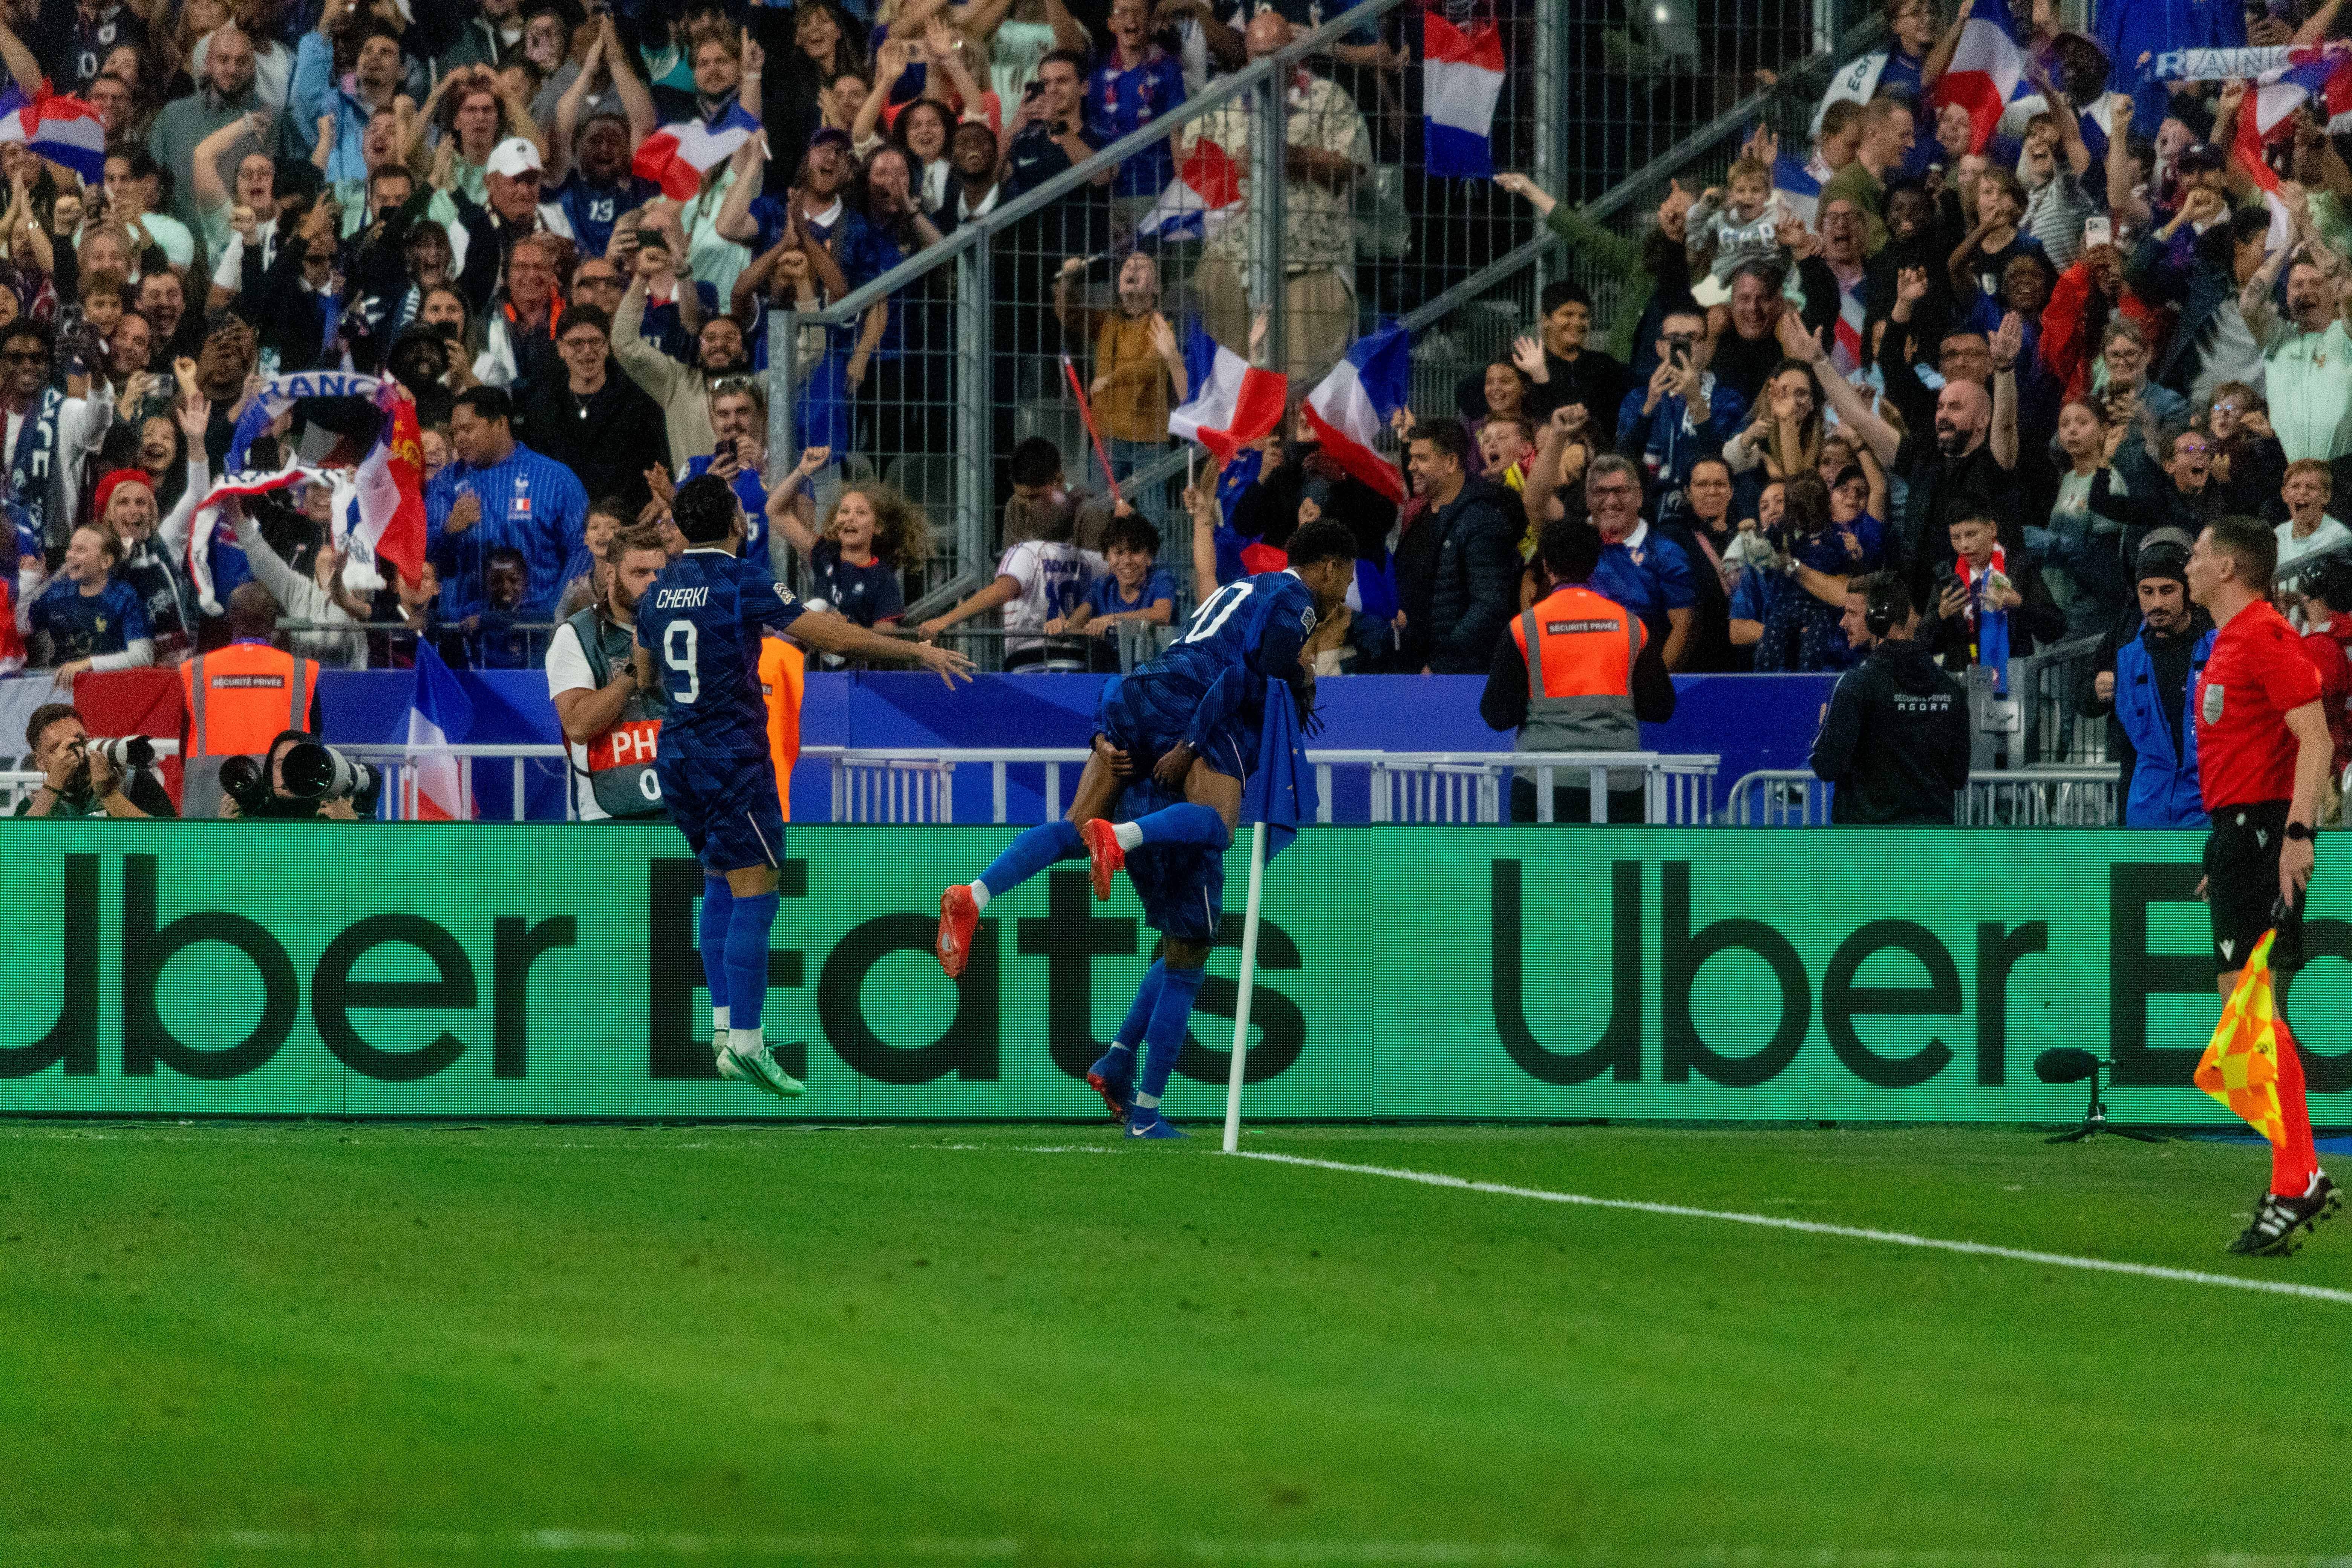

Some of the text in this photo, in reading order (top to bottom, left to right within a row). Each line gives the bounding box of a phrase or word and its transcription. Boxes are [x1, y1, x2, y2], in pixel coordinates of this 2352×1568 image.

[656, 586, 709, 608] CHERKI
[1169, 581, 1253, 646] 10
[1550, 622, 1618, 632] SÉCURITÉ PRIVÉE
[213, 677, 282, 687] SÉCURITÉ PRIVÉE
[663, 620, 699, 703] 9
[0, 853, 577, 1081] Uber
[1491, 859, 2047, 1089] Uber
